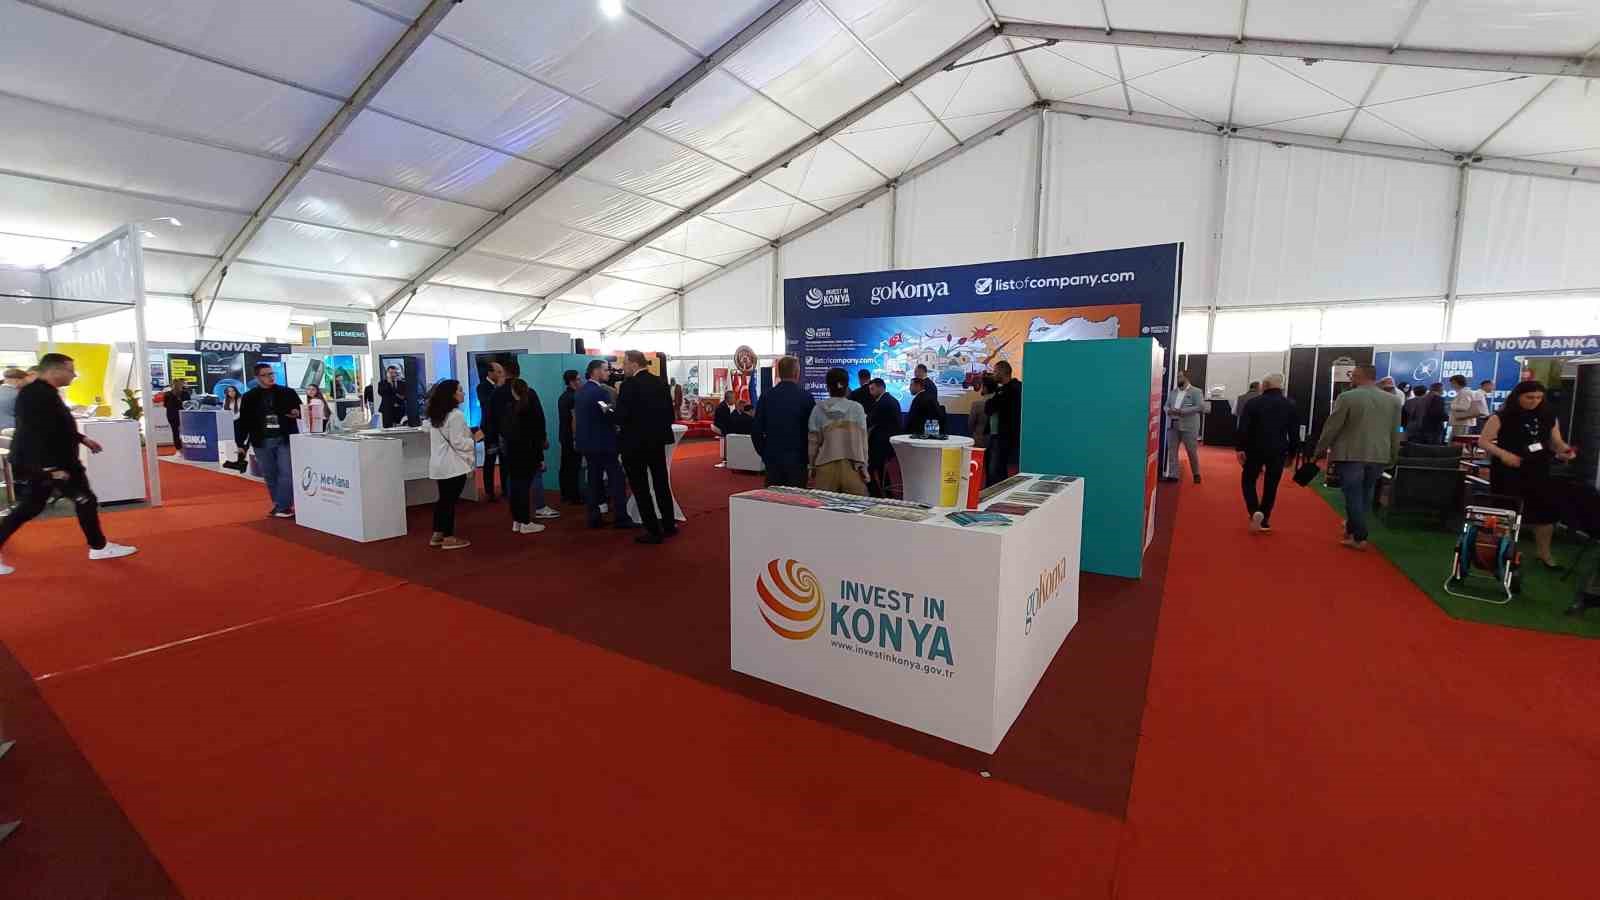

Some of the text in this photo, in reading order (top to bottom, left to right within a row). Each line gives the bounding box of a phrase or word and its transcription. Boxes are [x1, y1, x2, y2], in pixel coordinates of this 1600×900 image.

[995, 271, 1135, 291] listofcompany.com
[823, 295, 850, 305] KONYA
[870, 280, 949, 305] goKonya
[333, 330, 366, 338] SIEMENS
[200, 341, 261, 353] KONVAR
[1495, 338, 1600, 350] NOVA BANKA
[1443, 360, 1473, 369] NOVA
[1443, 369, 1473, 378] BANKA
[840, 580, 945, 621] INVEST IN
[1024, 556, 1066, 636] goKonya
[830, 602, 954, 666] KONYA
[830, 639, 955, 679] www.investinkonya.gov.tr
